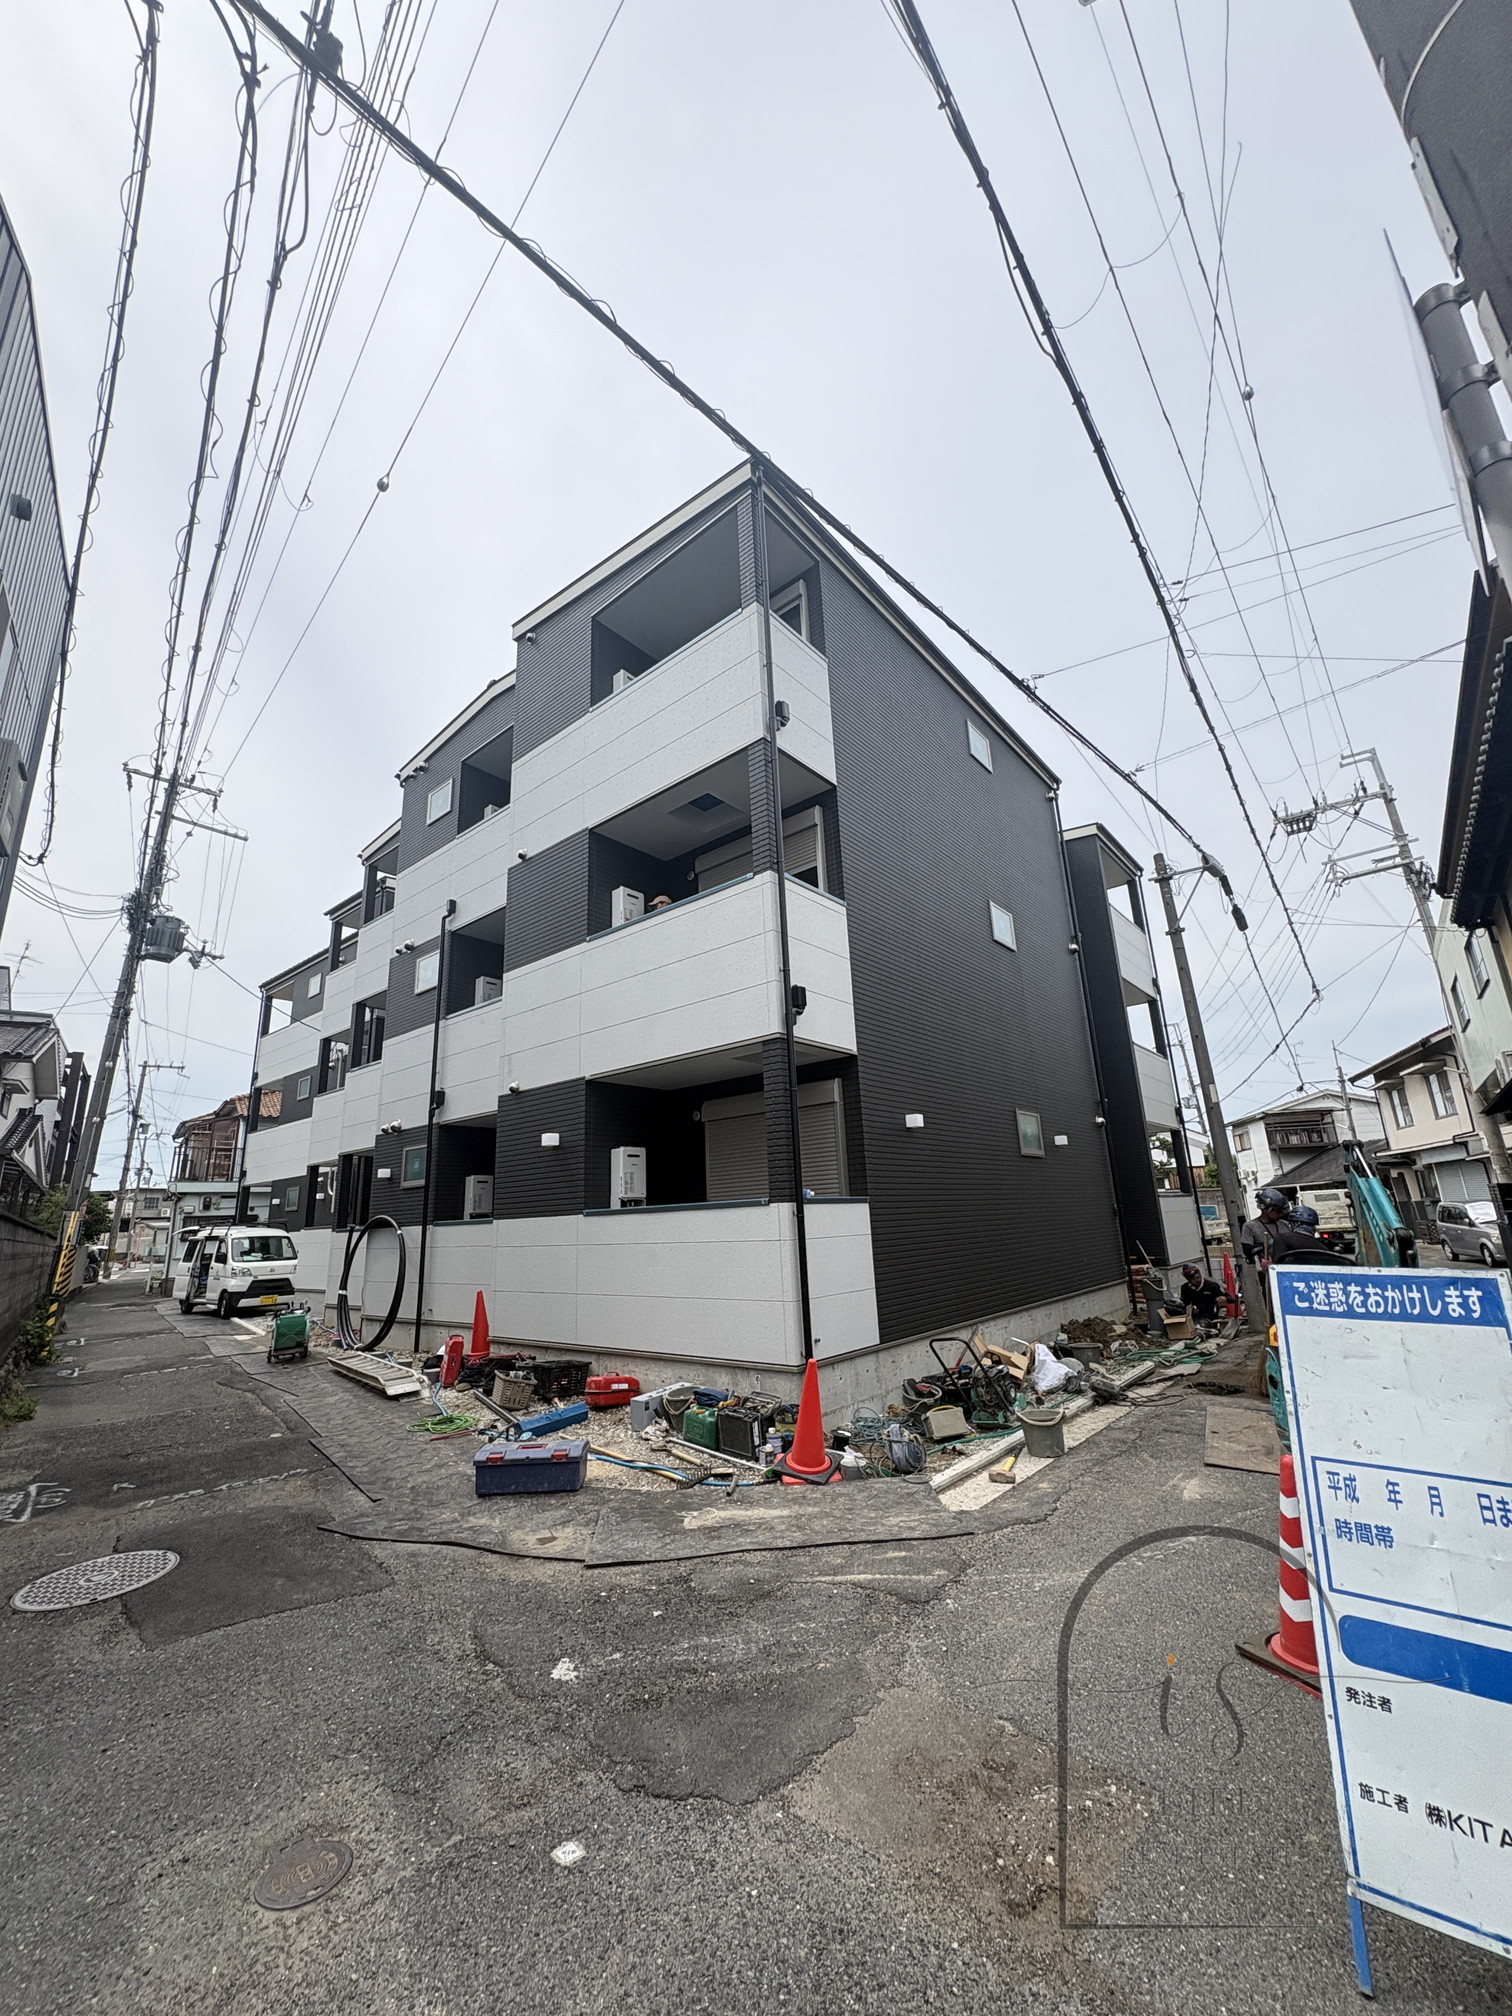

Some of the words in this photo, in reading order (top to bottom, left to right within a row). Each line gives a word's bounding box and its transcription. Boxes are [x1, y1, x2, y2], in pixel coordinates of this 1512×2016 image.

[1293, 1280, 1483, 1319] ご迷惑をおかけします
[1326, 1470, 1360, 1504] 平成
[1385, 1478, 1404, 1511] 年
[1427, 1485, 1444, 1518] 月
[1334, 1518, 1394, 1550] 時間帯
[1345, 1686, 1393, 1714] 発注者
[1358, 1782, 1409, 1814] 施工者
